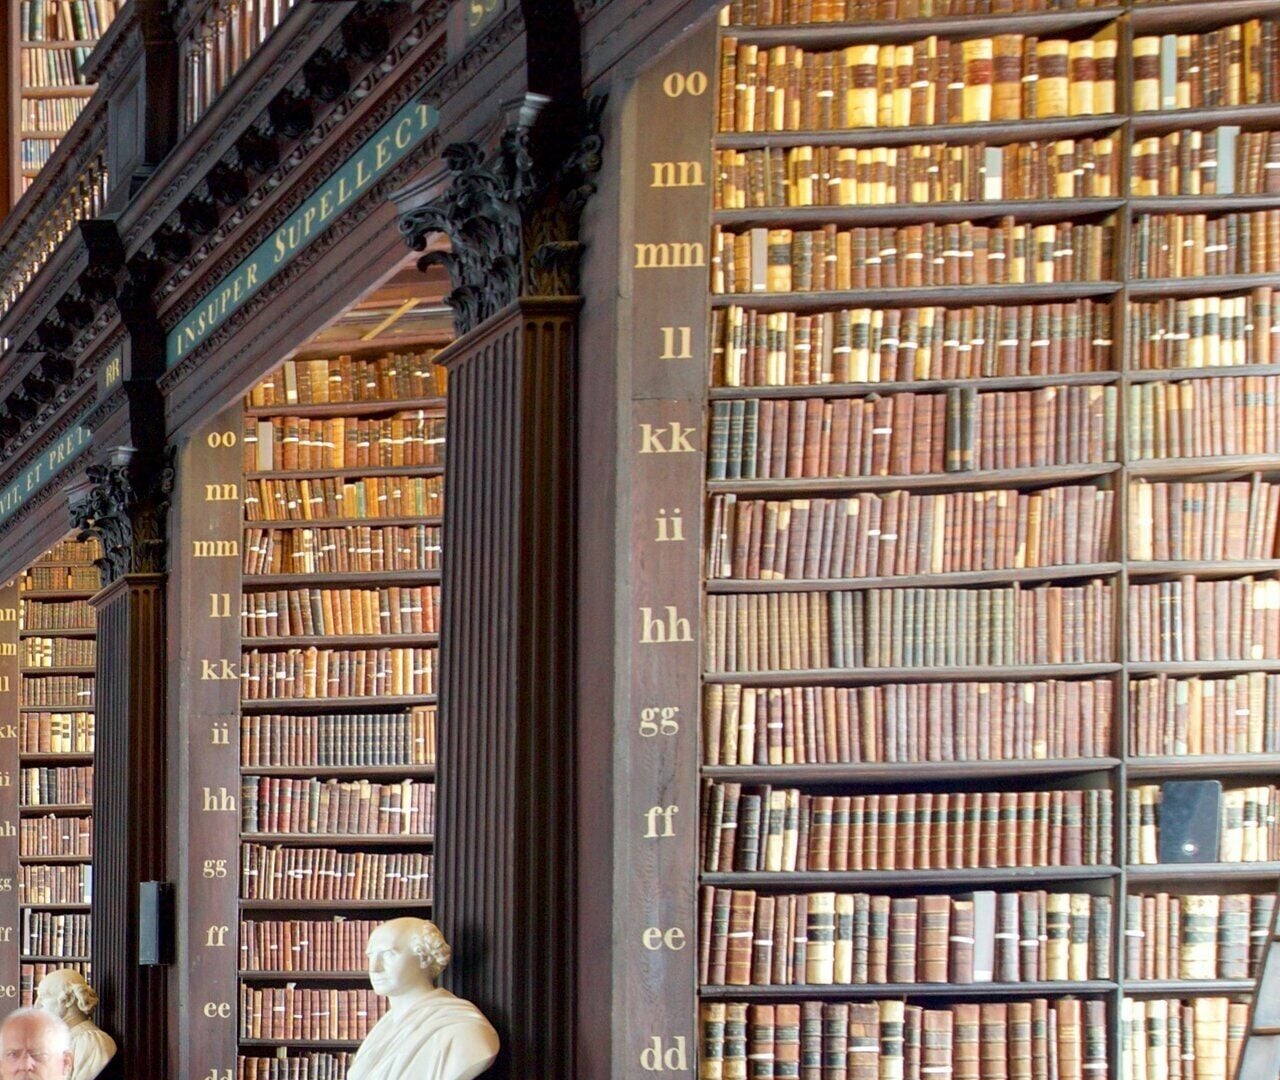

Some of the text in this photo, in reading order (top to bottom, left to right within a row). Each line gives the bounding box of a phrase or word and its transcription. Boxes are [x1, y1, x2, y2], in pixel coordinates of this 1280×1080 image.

[663, 72, 707, 98] oo
[651, 160, 705, 186] nn
[176, 104, 430, 356] INSUPER SUPELLECT
[634, 242, 705, 268] mm
[659, 326, 692, 358] ll
[105, 358, 120, 387] RR
[208, 432, 236, 448] oo
[639, 423, 696, 453] kk
[27, 463, 42, 491] ET
[205, 484, 238, 500] nn
[654, 509, 685, 541] ii
[193, 540, 238, 557] mm
[210, 593, 231, 617] ll
[639, 606, 694, 642] hh
[201, 659, 238, 680] kk
[211, 722, 230, 744] ii
[639, 706, 679, 737] gg
[202, 787, 236, 811] hh
[644, 806, 679, 838] ff
[203, 860, 227, 878] gg
[206, 926, 229, 946] ff
[642, 926, 686, 950] ee
[204, 1002, 230, 1018] ee
[640, 1036, 688, 1071] dd
